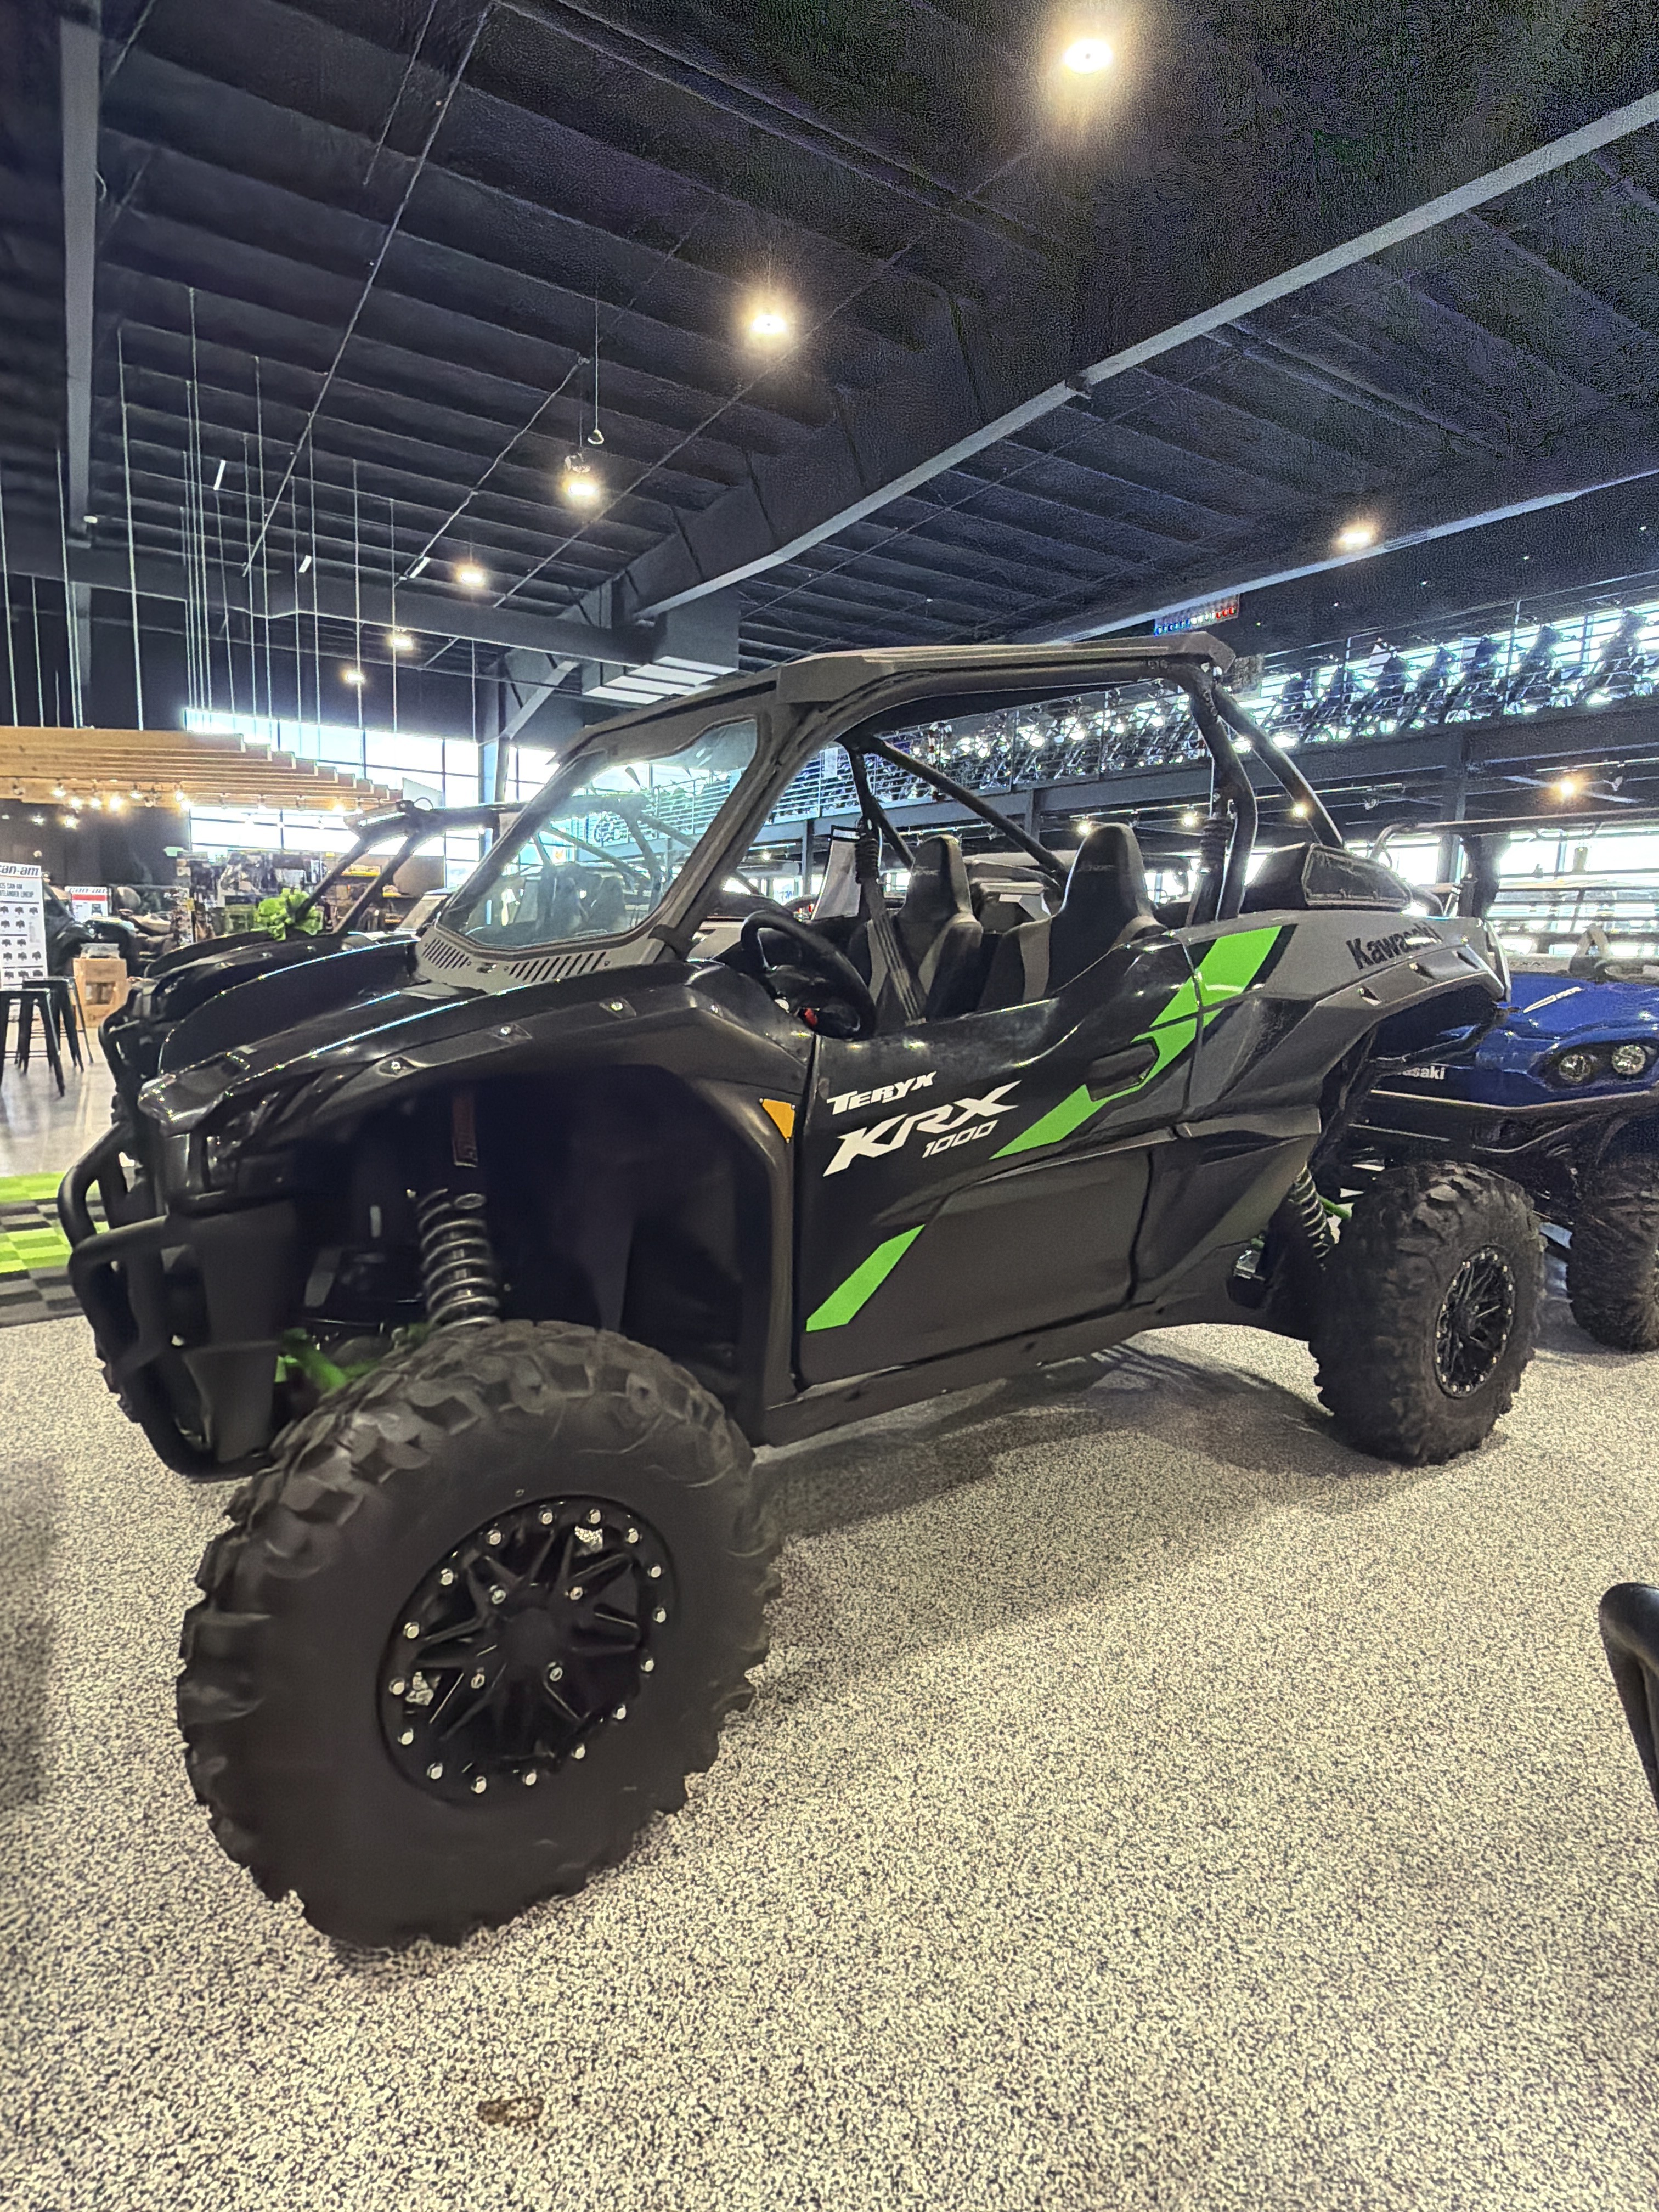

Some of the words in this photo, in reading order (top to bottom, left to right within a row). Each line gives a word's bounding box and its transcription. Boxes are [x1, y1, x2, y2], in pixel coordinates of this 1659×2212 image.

[0, 865, 39, 876] an-am
[823, 1080, 1022, 1177] KRX
[922, 1119, 998, 1159] 1000
